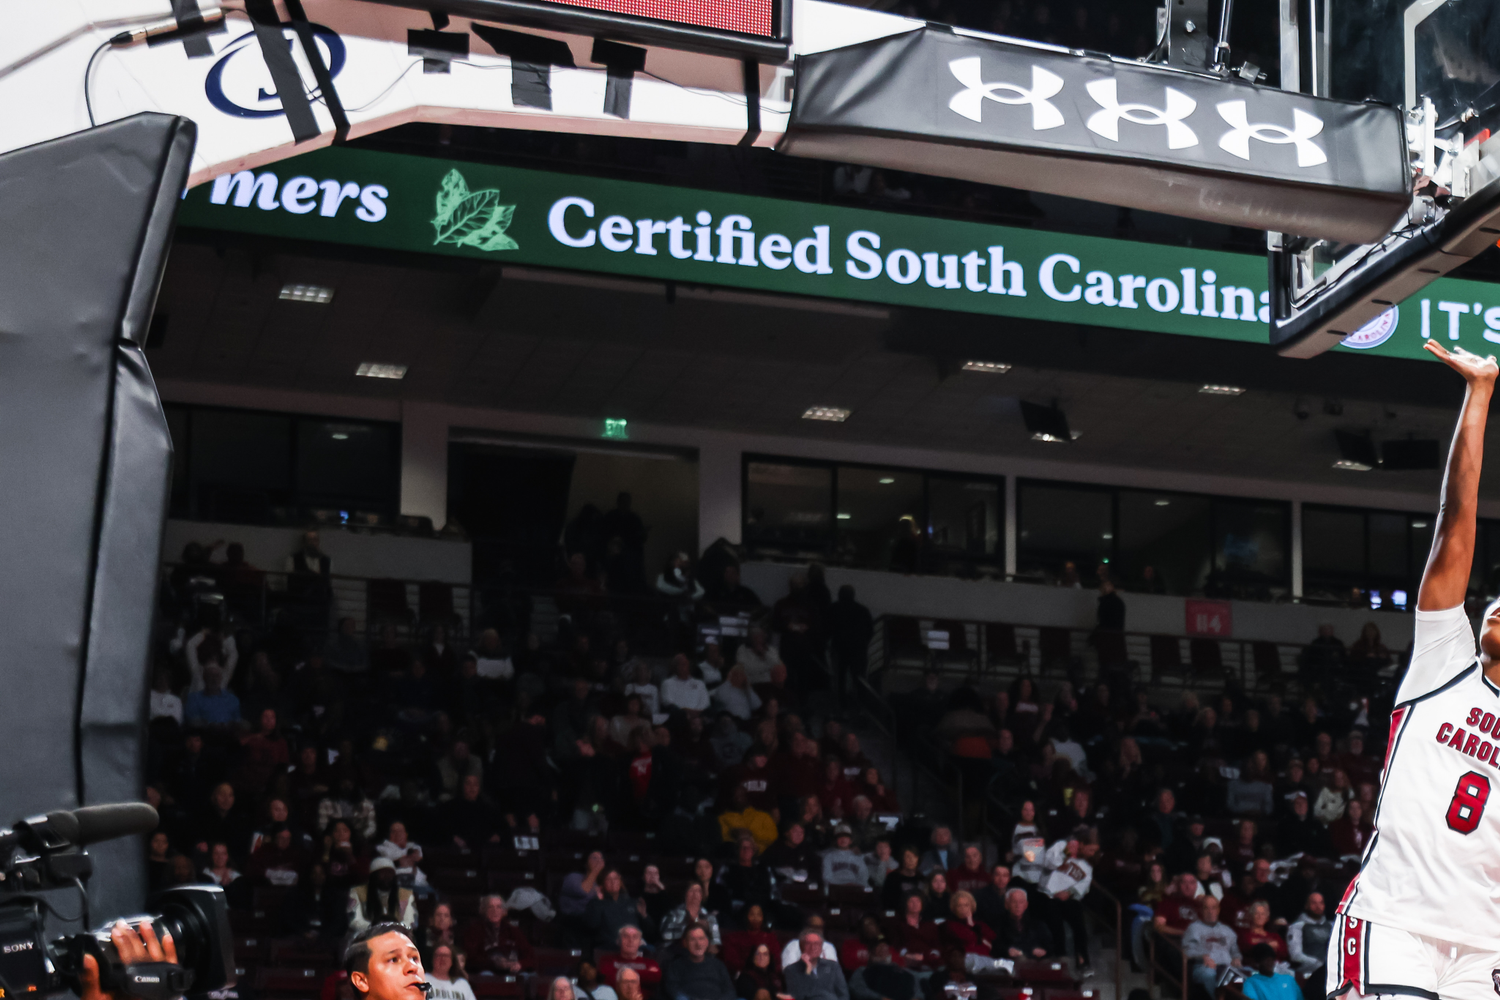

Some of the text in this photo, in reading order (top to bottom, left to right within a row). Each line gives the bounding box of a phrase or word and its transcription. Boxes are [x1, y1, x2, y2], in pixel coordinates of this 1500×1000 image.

[209, 169, 389, 223] mers
[549, 197, 1271, 324] Certified South Carolin
[1445, 770, 1491, 835] 8
[3, 941, 35, 954] SONY
[134, 974, 160, 984] Canon
